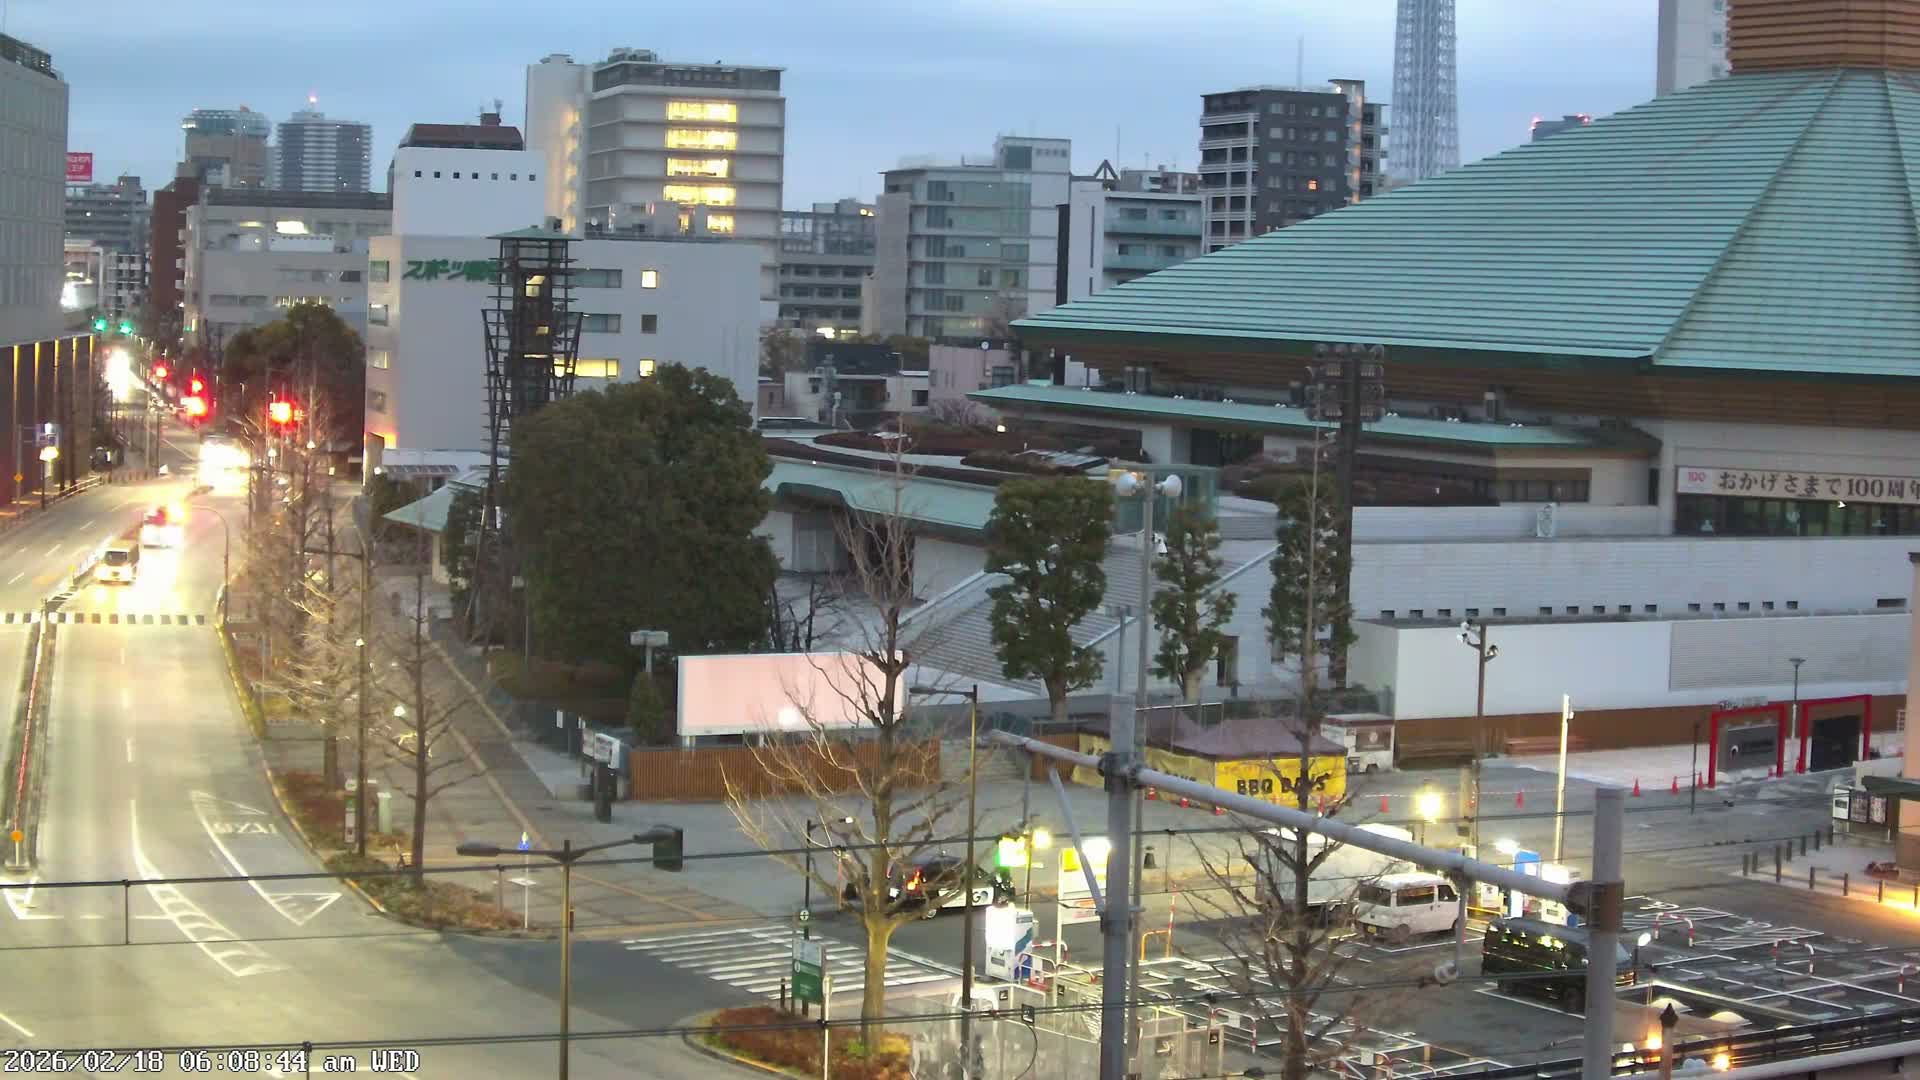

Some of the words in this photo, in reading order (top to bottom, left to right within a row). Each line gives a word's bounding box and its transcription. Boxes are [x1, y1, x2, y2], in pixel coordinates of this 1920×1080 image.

[402, 259, 500, 282] スポーツ
[1237, 779, 1273, 795] BBQ
[1281, 777, 1325, 793] DAS
